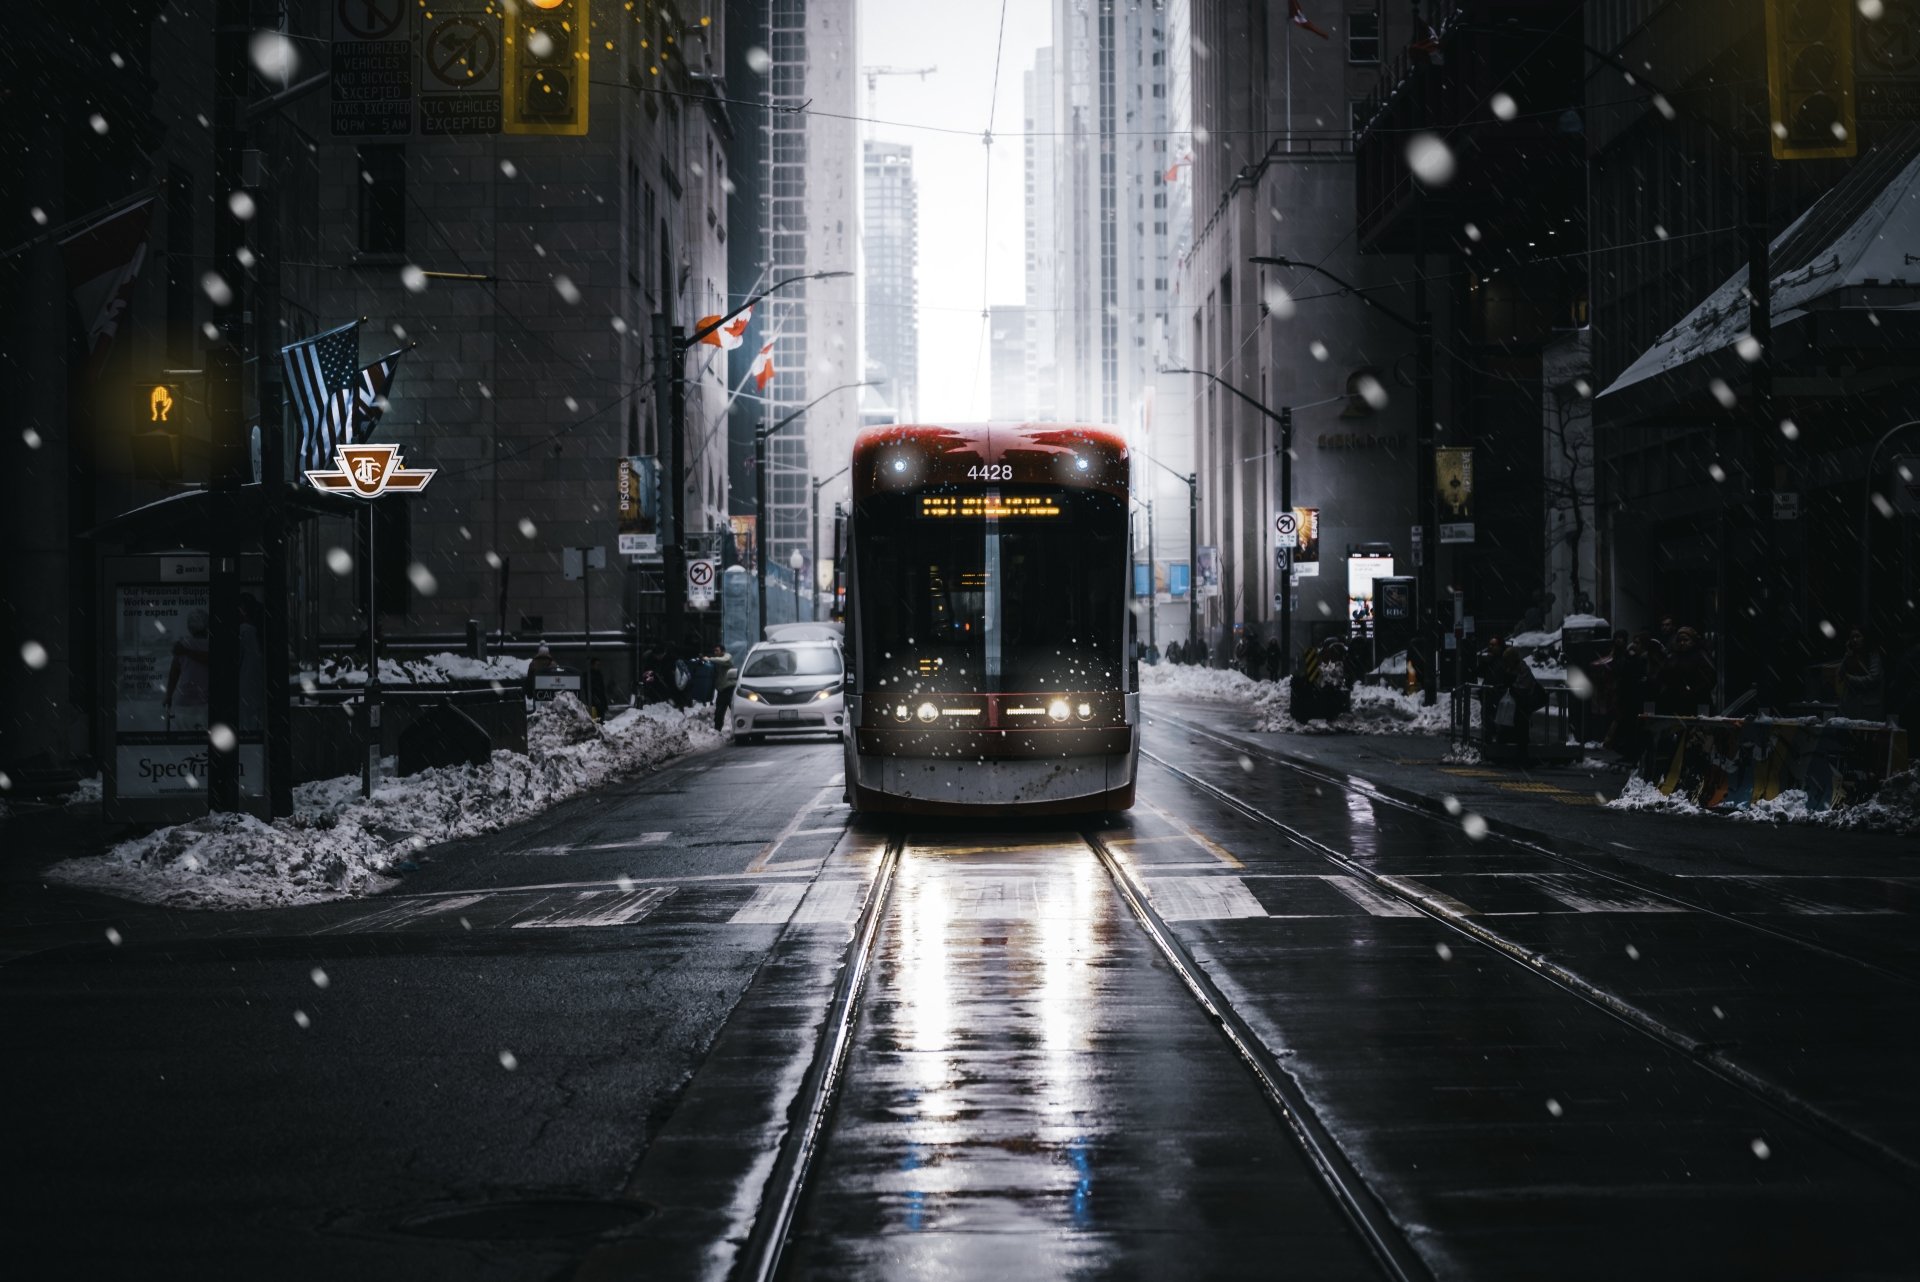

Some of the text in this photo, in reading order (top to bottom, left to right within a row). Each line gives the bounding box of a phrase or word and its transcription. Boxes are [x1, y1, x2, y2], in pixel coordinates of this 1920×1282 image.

[335, 41, 408, 55] AUTHORIZED
[343, 57, 400, 70] VEHICLES
[333, 71, 410, 84] AND BICYCLES
[342, 86, 401, 99] EXCEPTED
[332, 102, 411, 115] TAXIS EXCEPTED
[423, 100, 500, 113] TTC VEHICLES
[426, 117, 496, 130] EXCEPTED
[967, 464, 1013, 481] 4428
[620, 461, 629, 510] DISCOVER
[123, 597, 160, 606] Workers
[178, 596, 207, 606] health
[144, 608, 178, 618] experts
[1386, 608, 1405, 616] RBC
